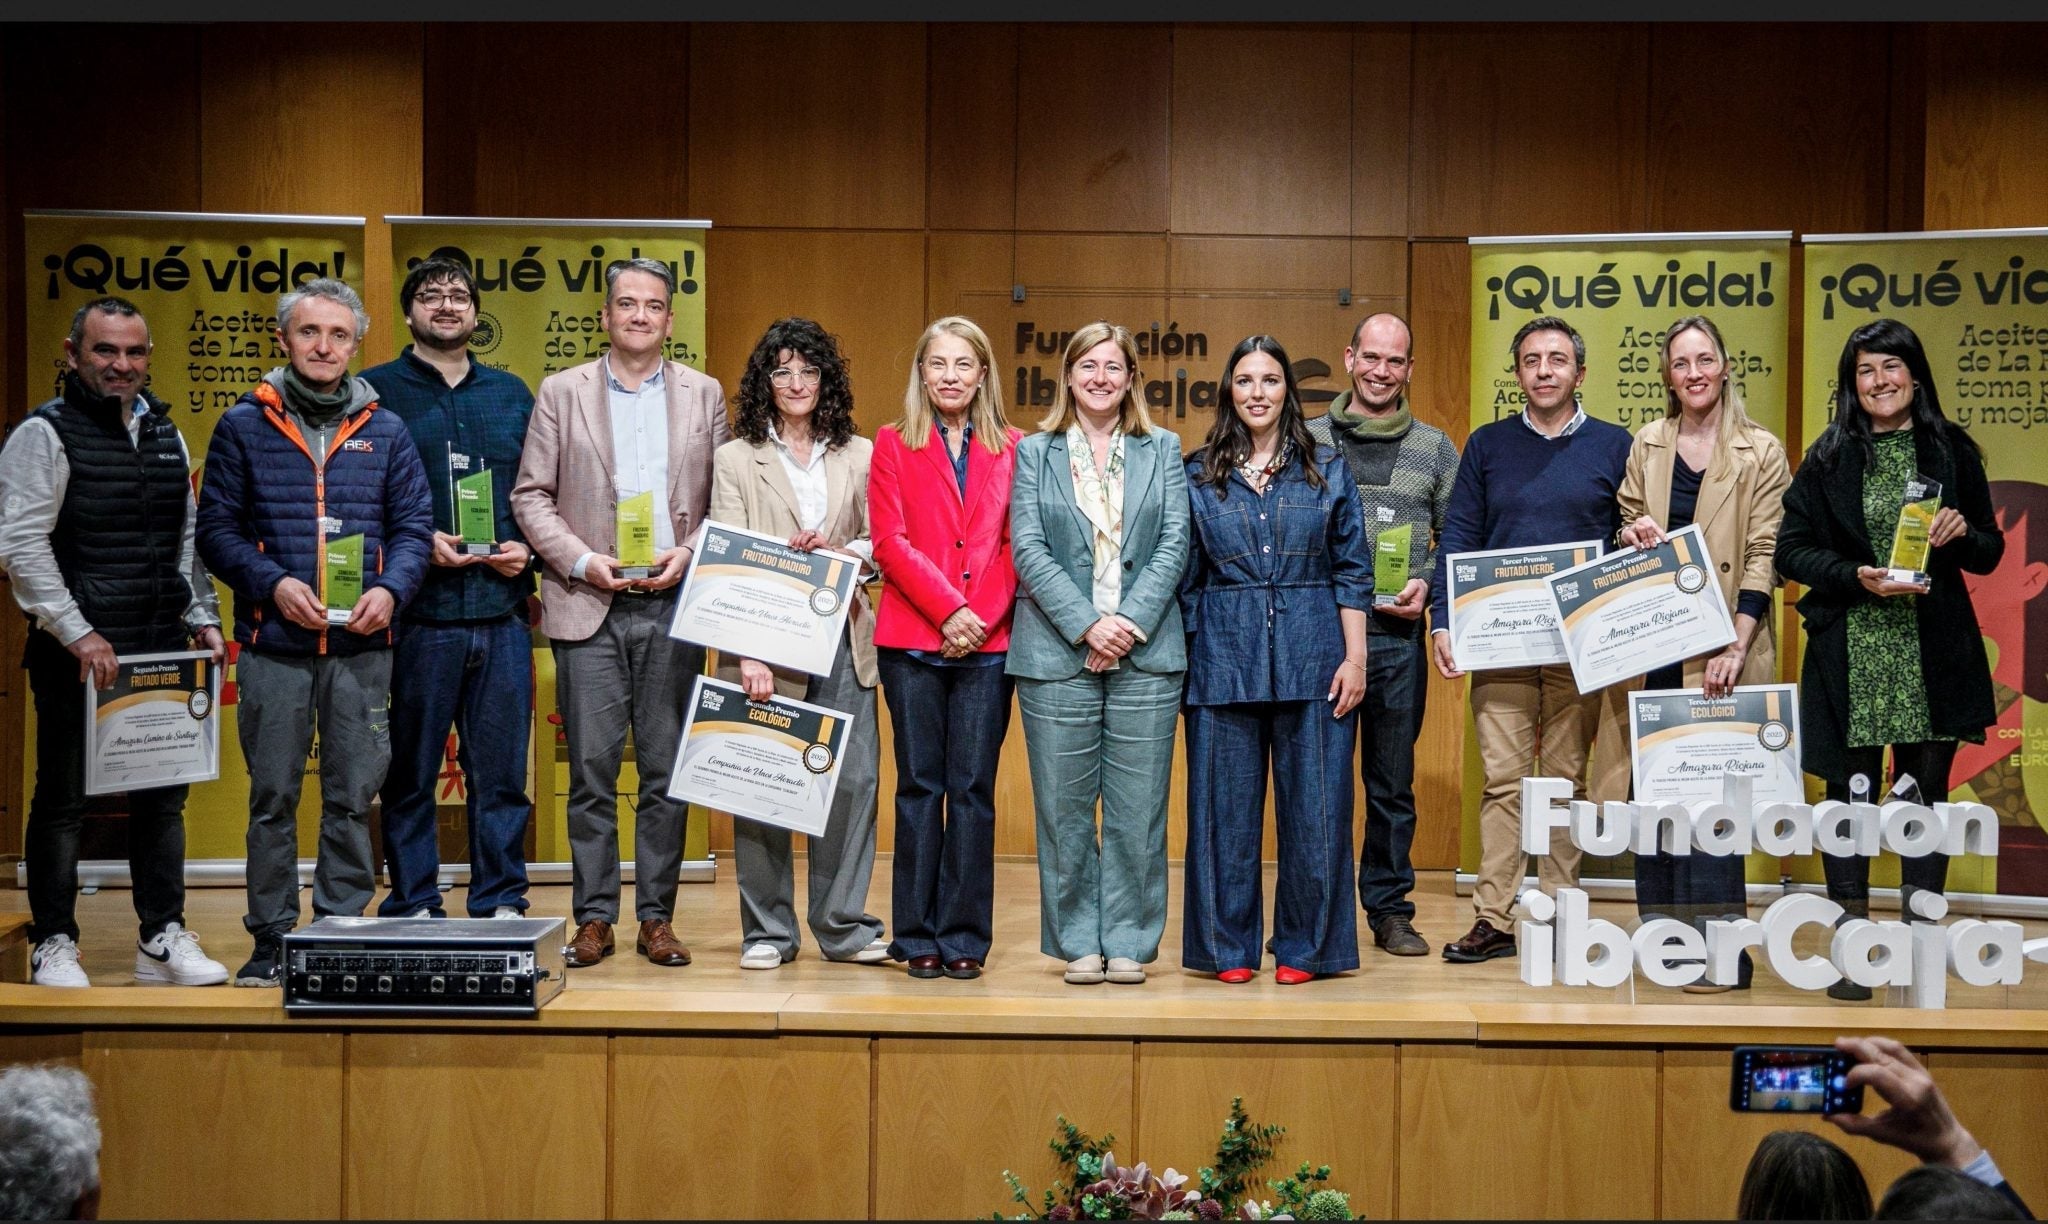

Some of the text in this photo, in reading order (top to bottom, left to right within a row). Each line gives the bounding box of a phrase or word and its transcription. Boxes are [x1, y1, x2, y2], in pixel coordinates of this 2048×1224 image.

[44, 243, 190, 299] ¡Qué
[1486, 260, 1774, 320] ¡Qué vida!
[1820, 259, 1961, 320] ¡Qué
[1016, 321, 1208, 357] Función
[1959, 322, 2048, 346] Aceite
[188, 335, 221, 357] de
[229, 336, 261, 358] La
[545, 336, 577, 358] de
[1618, 352, 1650, 373] de
[1958, 350, 1991, 372] de
[1998, 349, 2031, 371] La
[187, 362, 262, 383] toma
[1016, 366, 1217, 418] ibaja
[1617, 379, 1666, 398] tom
[1956, 378, 2032, 398] toma
[189, 391, 206, 413] y
[1618, 407, 1633, 428] y
[1957, 407, 1973, 429] y
[741, 548, 812, 576] FRUTADO MADURO
[752, 541, 808, 562] Segundo Premio
[1501, 555, 1548, 566] Tercer Premio
[1495, 562, 1555, 578] FRUTADO VERDE
[1593, 568, 1629, 590] FRUTADO
[1628, 557, 1662, 580] MADURO
[1600, 553, 1648, 574] Tercer Premio
[1481, 617, 1533, 631] Almazara
[1599, 619, 1650, 644] Almazara
[1651, 606, 1690, 625] Riojana
[131, 672, 181, 688] FRUTADO VERDE
[133, 664, 179, 675] Segundo Premio
[748, 708, 792, 729] ECOLÓGICO
[775, 706, 800, 719] Premio
[1691, 704, 1736, 719] ECOLÓGICO
[1667, 758, 1766, 775] Almazara Riojana
[1521, 773, 1999, 857] Fundación
[1521, 887, 2024, 1009] iberCaja
